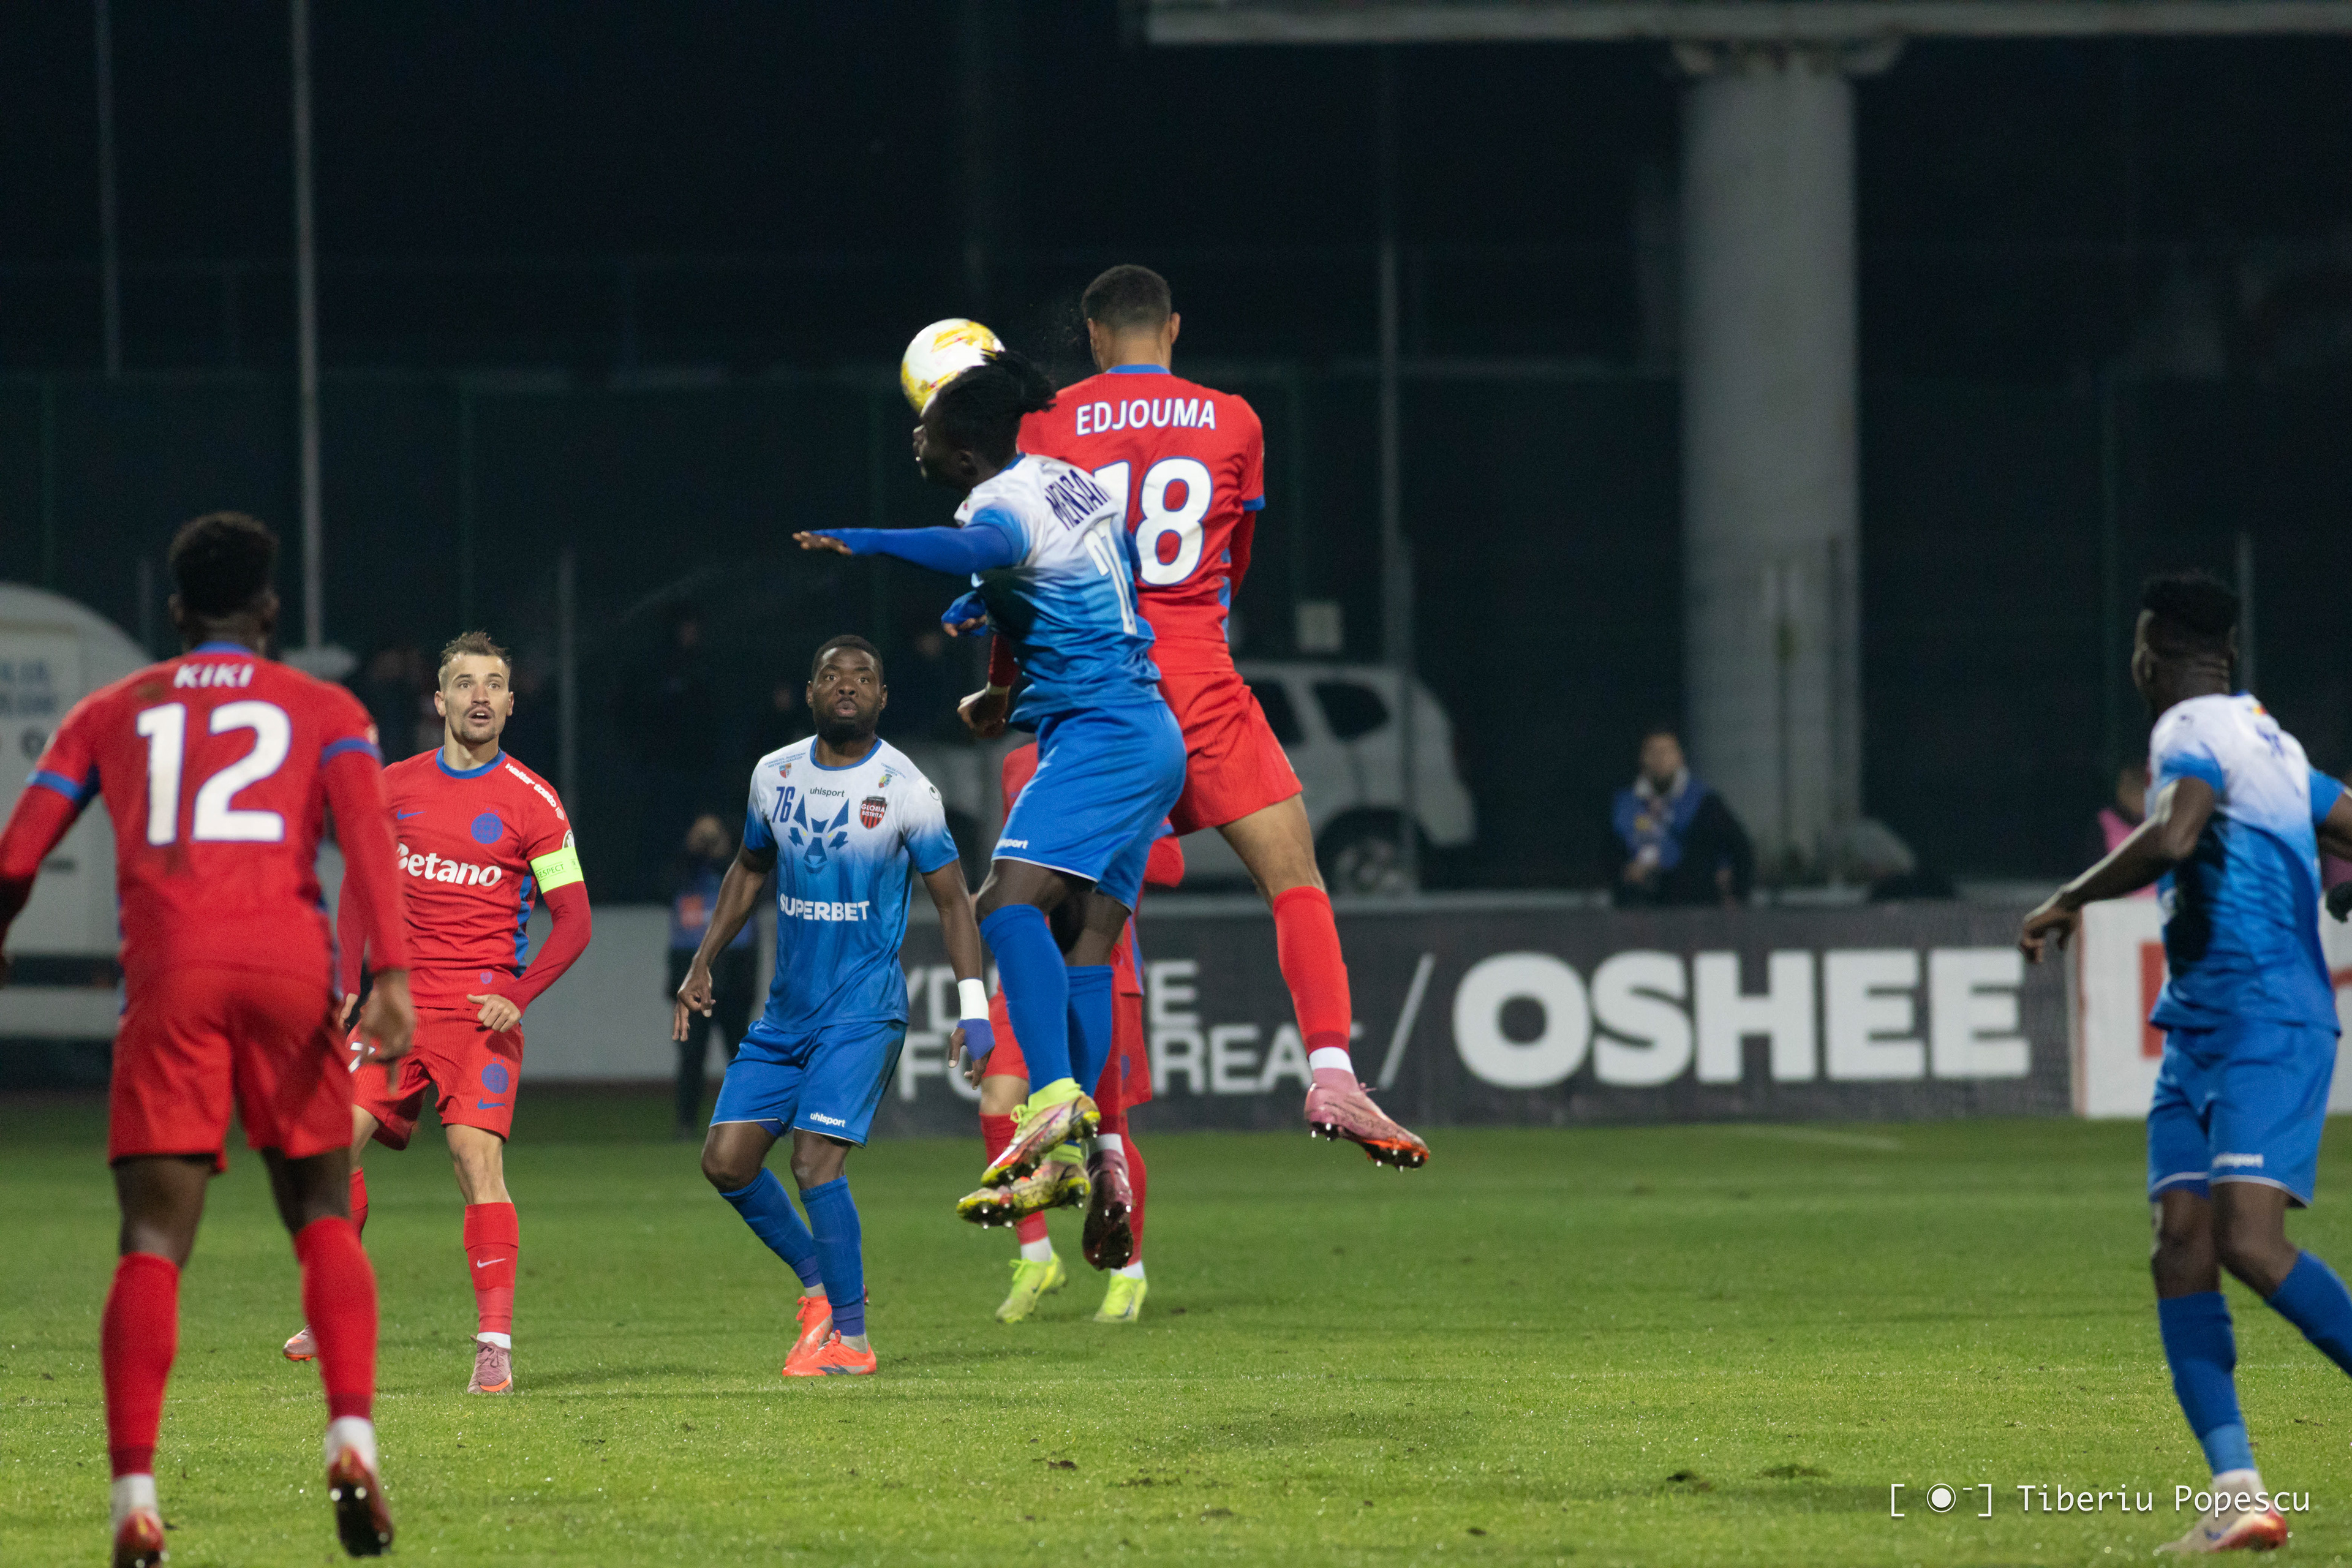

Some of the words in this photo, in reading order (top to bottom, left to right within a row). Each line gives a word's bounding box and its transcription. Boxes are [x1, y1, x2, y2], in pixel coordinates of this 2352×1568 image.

[1076, 398, 1216, 436] EDJOUMA
[173, 663, 254, 688] KIKI
[136, 701, 292, 846] 12
[772, 786, 796, 823] 76
[810, 786, 845, 797] uhlsport
[861, 804, 885, 813] GLORIA
[536, 864, 564, 880] RESPECT
[780, 893, 870, 921] SUPERBET
[1453, 948, 2032, 1089] OSHEE
[810, 1112, 846, 1128] uhlsport
